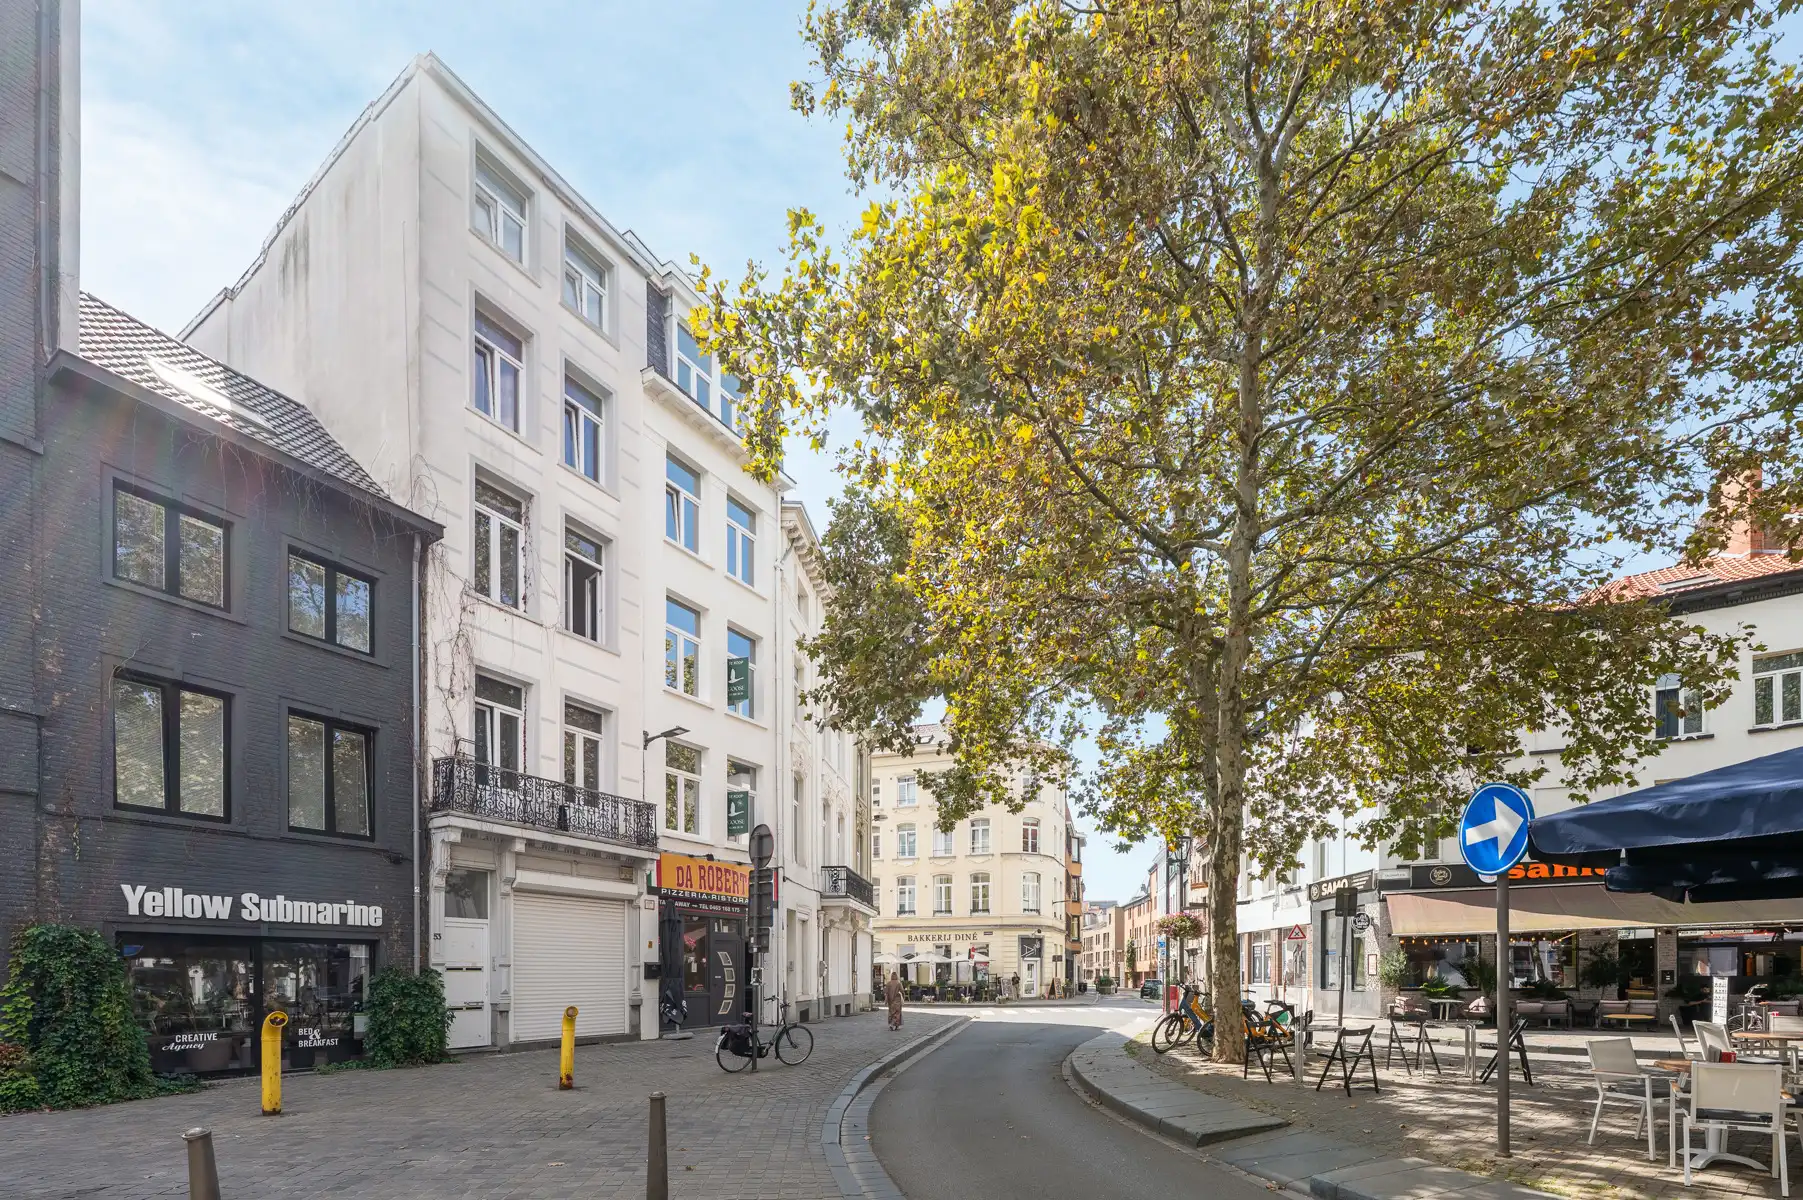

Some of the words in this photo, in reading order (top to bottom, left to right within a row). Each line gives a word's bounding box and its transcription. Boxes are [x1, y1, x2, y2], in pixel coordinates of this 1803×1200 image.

[1508, 863, 1606, 879] sam
[676, 865, 693, 888] DA
[699, 864, 749, 896] ROBERT
[120, 884, 233, 920] Yellow
[241, 892, 383, 927] Submarine
[908, 934, 951, 942] BAKKERIJ
[955, 932, 978, 940] DINÉ
[175, 1033, 218, 1043] CREATIVE
[309, 1028, 321, 1040] &
[162, 1042, 205, 1051] Agency
[298, 1038, 339, 1048] BREAKFAST
